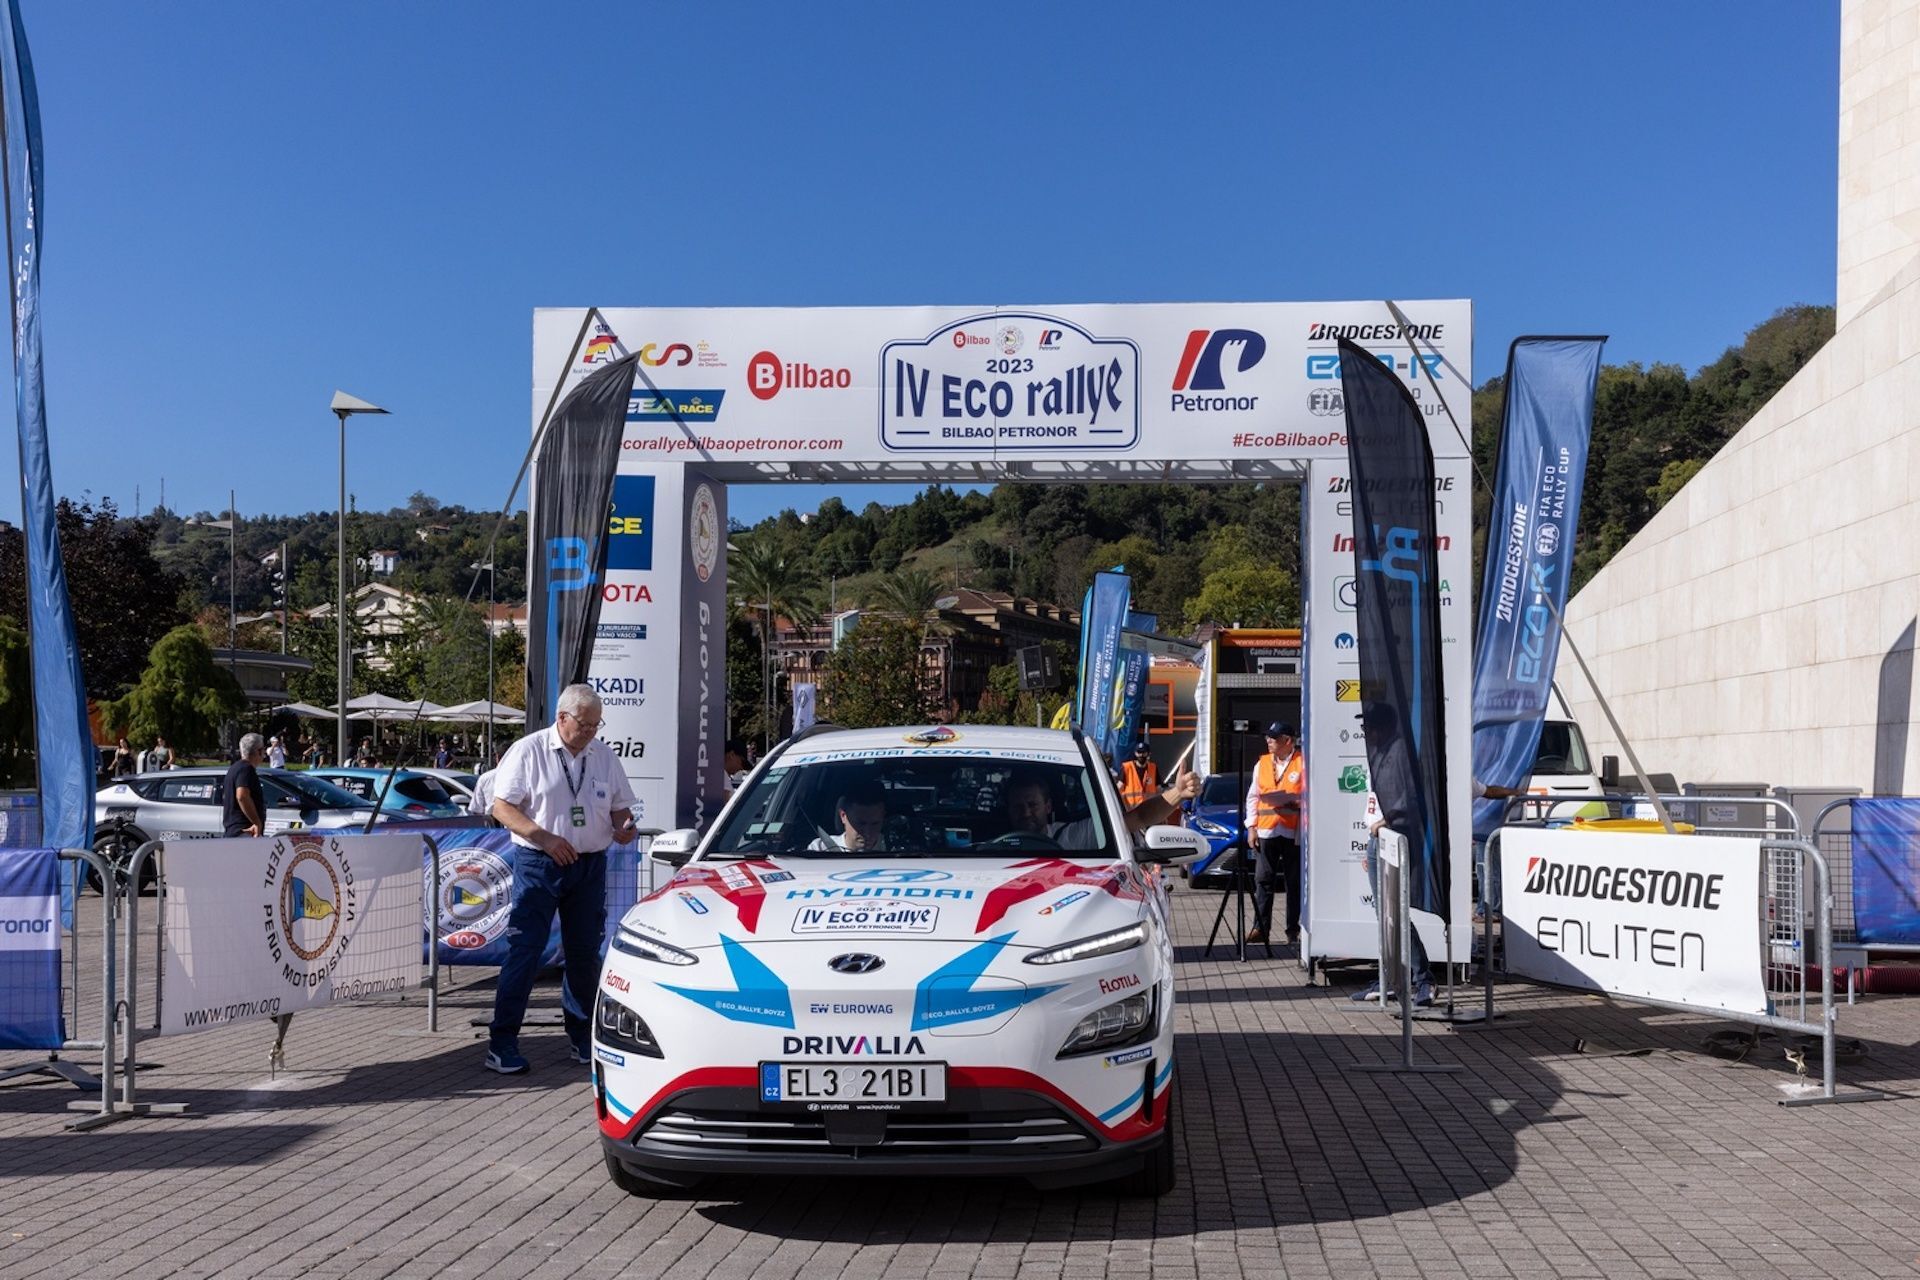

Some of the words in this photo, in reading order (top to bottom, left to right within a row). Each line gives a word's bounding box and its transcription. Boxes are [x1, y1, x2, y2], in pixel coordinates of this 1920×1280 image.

[953, 330, 990, 348] Bilbao
[1308, 323, 1445, 341] BRIDGESTONE
[747, 350, 851, 400] Bilbao
[986, 358, 1034, 374] 2023
[896, 358, 930, 417] IV
[942, 373, 1013, 418] ECO
[1026, 357, 1122, 425] rallye
[679, 404, 714, 414] RACE
[1171, 394, 1259, 412] Petronor
[942, 426, 994, 438] BILBAO
[999, 426, 1077, 438] PETRONOR
[1558, 447, 1570, 473] CUP
[1543, 465, 1556, 493] ECO
[1539, 496, 1550, 517] FIA
[1551, 476, 1567, 518] RALLY
[608, 516, 643, 535] CE
[1540, 525, 1556, 554] FIA
[1496, 502, 1528, 623] BRIDGESTONE
[602, 584, 653, 603] OTA
[587, 678, 645, 694] SKADI
[826, 749, 905, 760] HYUNDAI
[912, 748, 993, 757] KONA
[1000, 751, 1063, 762] electric
[264, 839, 285, 889] REAL
[330, 838, 356, 922] VIZCAYA
[1523, 857, 1724, 911] BRIDGESTONE
[786, 888, 975, 900] HYUNDAI
[802, 909, 825, 924] IV
[828, 912, 868, 924] ECO
[875, 908, 931, 926] rallye
[264, 904, 282, 964] PEÑA
[456, 934, 478, 946] 100
[1537, 916, 1704, 972] ENLITEN
[282, 935, 349, 988] MOTORISTA
[330, 975, 406, 1001] info@rpmv.org
[1099, 973, 1141, 995] FLOTILA
[184, 996, 281, 1028] www.rpmv.org
[833, 1004, 894, 1014] EUROWAG
[783, 1036, 926, 1055] DRIVALIA
[1116, 1048, 1151, 1064] MICHELIN
[765, 1087, 779, 1097] CZ
[786, 1068, 838, 1097] EL3
[861, 1068, 927, 1097] 21BI
